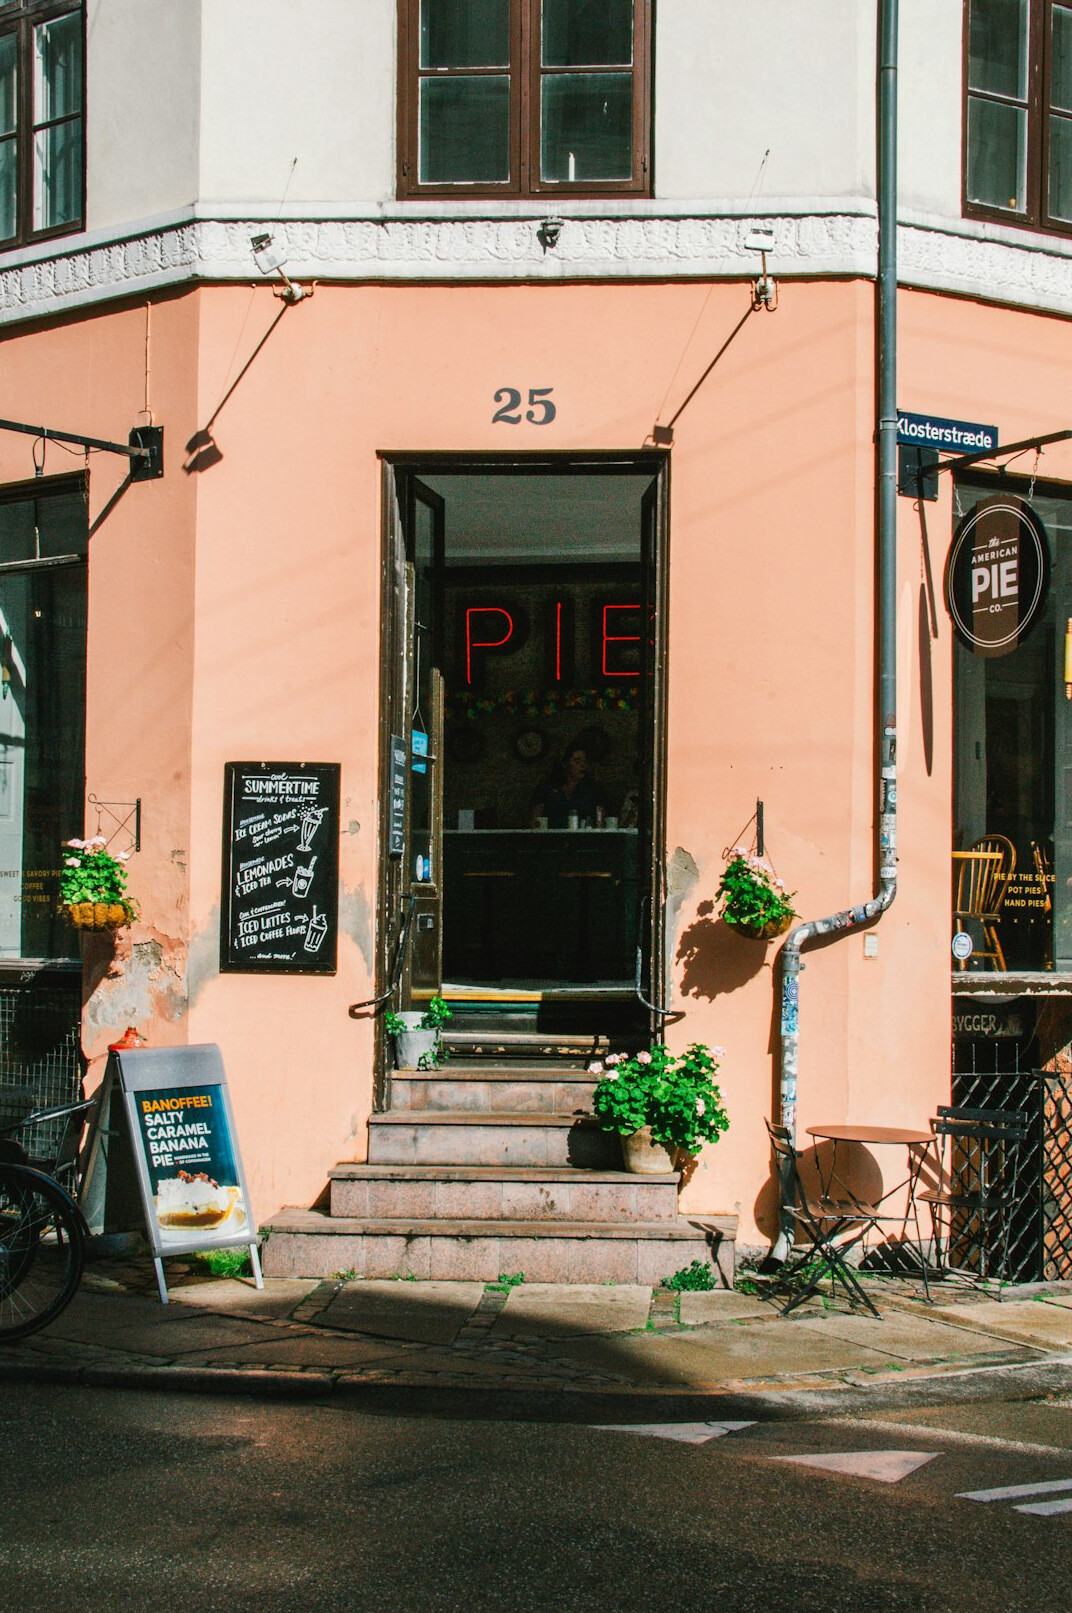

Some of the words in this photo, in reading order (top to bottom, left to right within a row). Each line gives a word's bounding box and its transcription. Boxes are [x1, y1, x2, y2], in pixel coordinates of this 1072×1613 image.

[492, 387, 557, 425] 25
[897, 417, 992, 448] Klosterstræde
[988, 537, 1000, 548] the
[971, 546, 1018, 565] AMERICAN
[971, 560, 1019, 603] PIE
[989, 603, 1003, 614] CO.
[466, 602, 640, 684] PIE
[270, 772, 288, 781] cool
[244, 780, 320, 794] SUMMERTIME
[234, 828, 247, 841] ICE
[249, 819, 272, 835] CREAM
[273, 809, 297, 824] SODAS
[0, 870, 19, 878] SWEET
[26, 869, 50, 877] SAVORY
[51, 869, 62, 877] PIE
[236, 853, 294, 886] LEMONADES
[993, 873, 1006, 881] PIE
[1007, 873, 1017, 881] BY
[1019, 873, 1033, 881] THE
[1035, 873, 1056, 882] SLICE
[242, 880, 258, 895] ICED
[258, 876, 272, 888] TEA
[1008, 886, 1023, 894] POT
[1025, 886, 1041, 895] PIES
[1004, 899, 1026, 907] HAND
[1027, 899, 1044, 907] PIES
[237, 920, 259, 938] ICED
[261, 912, 291, 930] LATTES
[240, 933, 259, 948] ICED
[260, 928, 284, 942] COFFEE
[286, 925, 307, 936] FLOATS
[273, 951, 297, 961] more!
[142, 1095, 212, 1113] BANOFFEE!
[144, 1110, 184, 1127] SALTY
[147, 1122, 211, 1140] CARAMEL
[149, 1136, 208, 1154] BANANA
[152, 1153, 174, 1168] PIE
